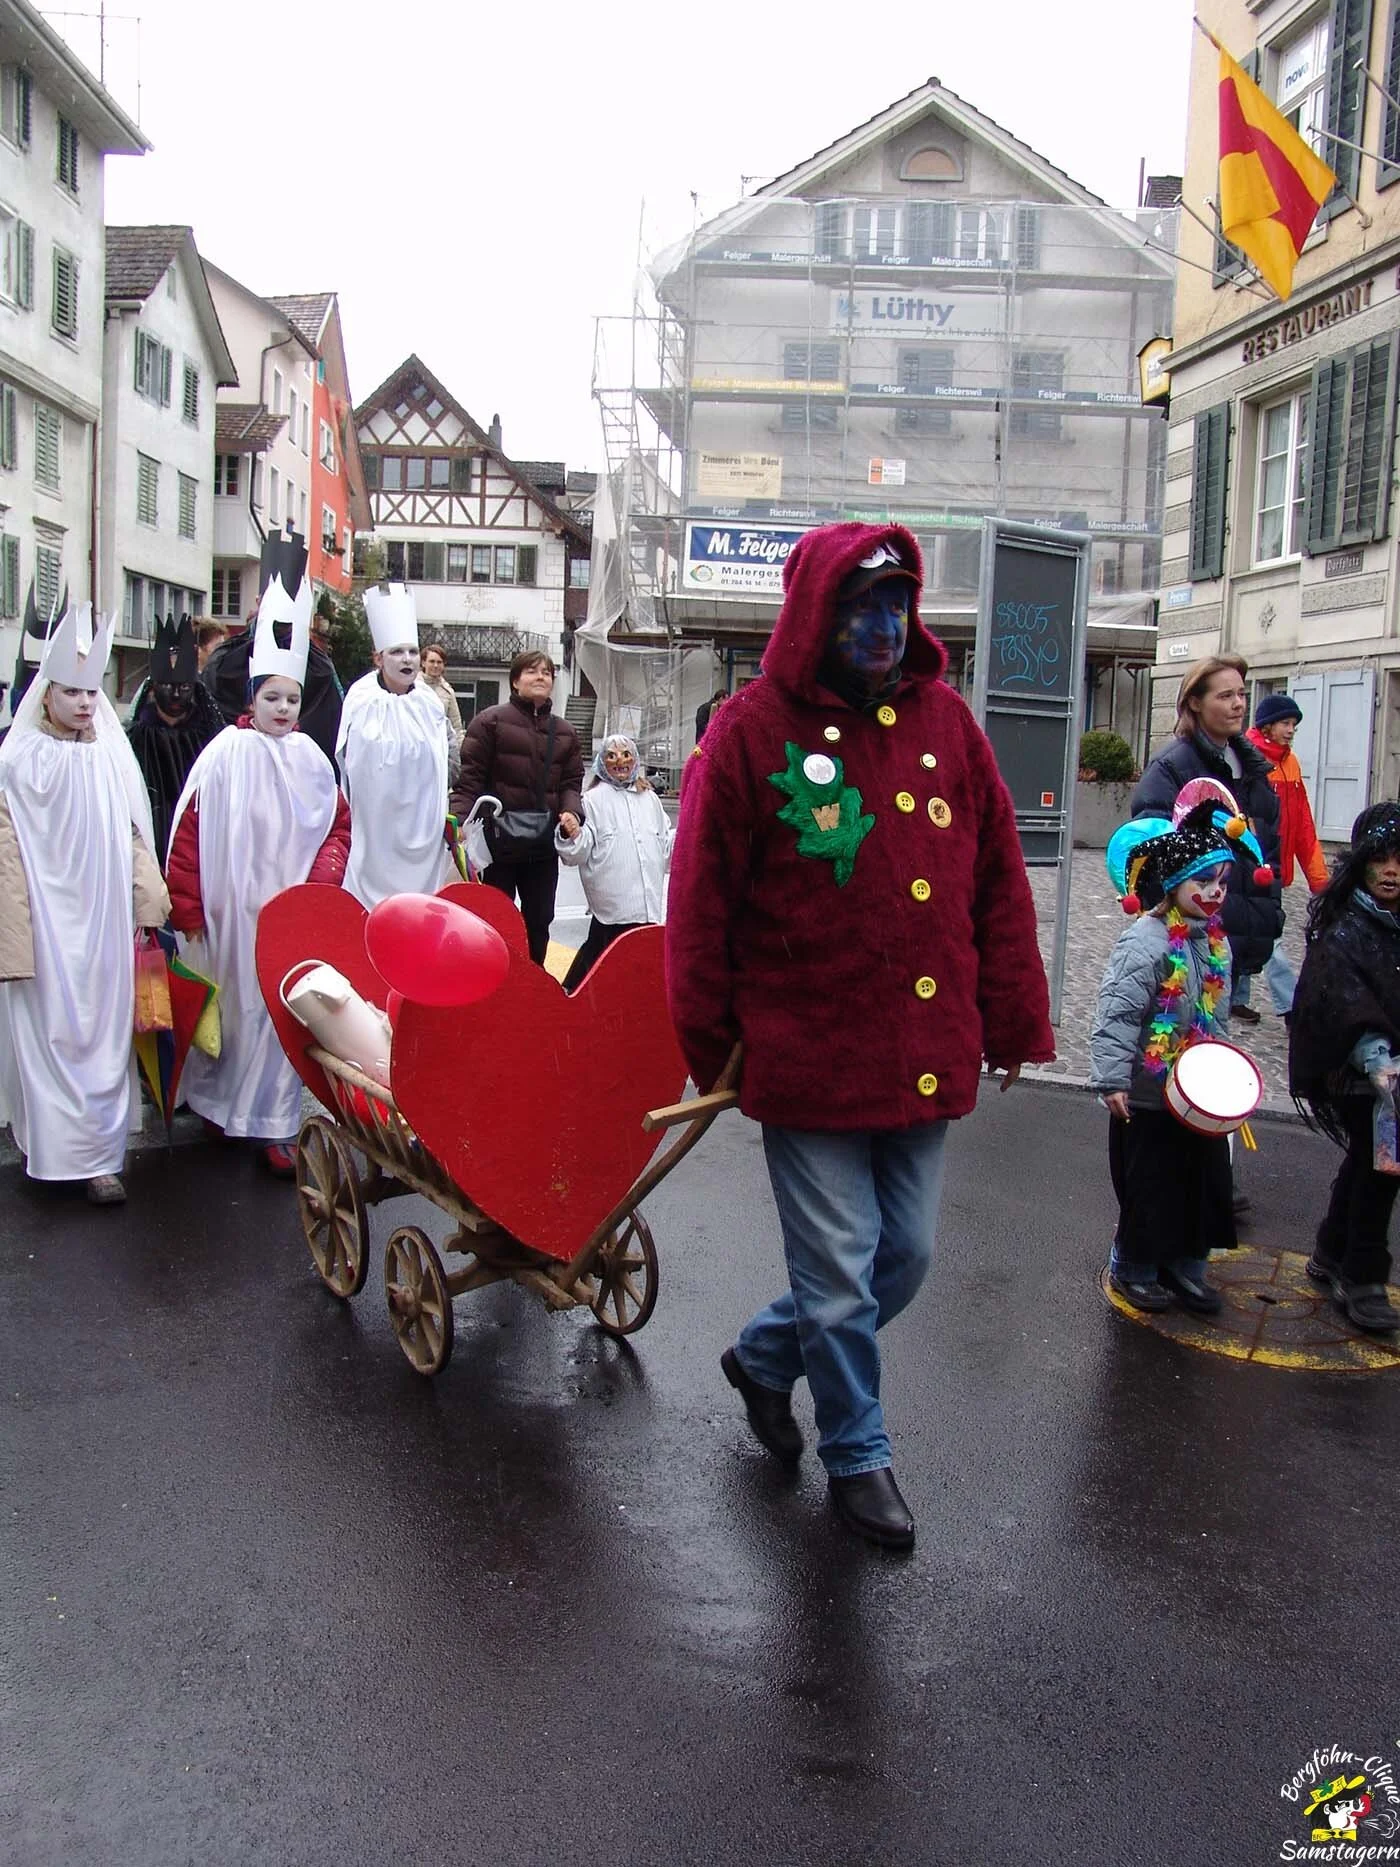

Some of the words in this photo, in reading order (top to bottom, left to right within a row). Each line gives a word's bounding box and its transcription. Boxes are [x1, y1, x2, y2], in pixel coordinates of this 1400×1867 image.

[723, 250, 751, 261] Felger
[881, 254, 910, 265] Felger
[931, 256, 992, 268] Malergeschäft
[872, 297, 954, 326] Lüthy
[1243, 279, 1374, 363] RESTAURANT
[877, 384, 907, 395] Felger
[1038, 389, 1067, 400] Felger
[702, 455, 742, 465] Zimmerei
[712, 505, 741, 517] Felger
[1087, 520, 1149, 532] Malergeschäft
[707, 531, 735, 555] M.
[721, 566, 781, 578] Malerges
